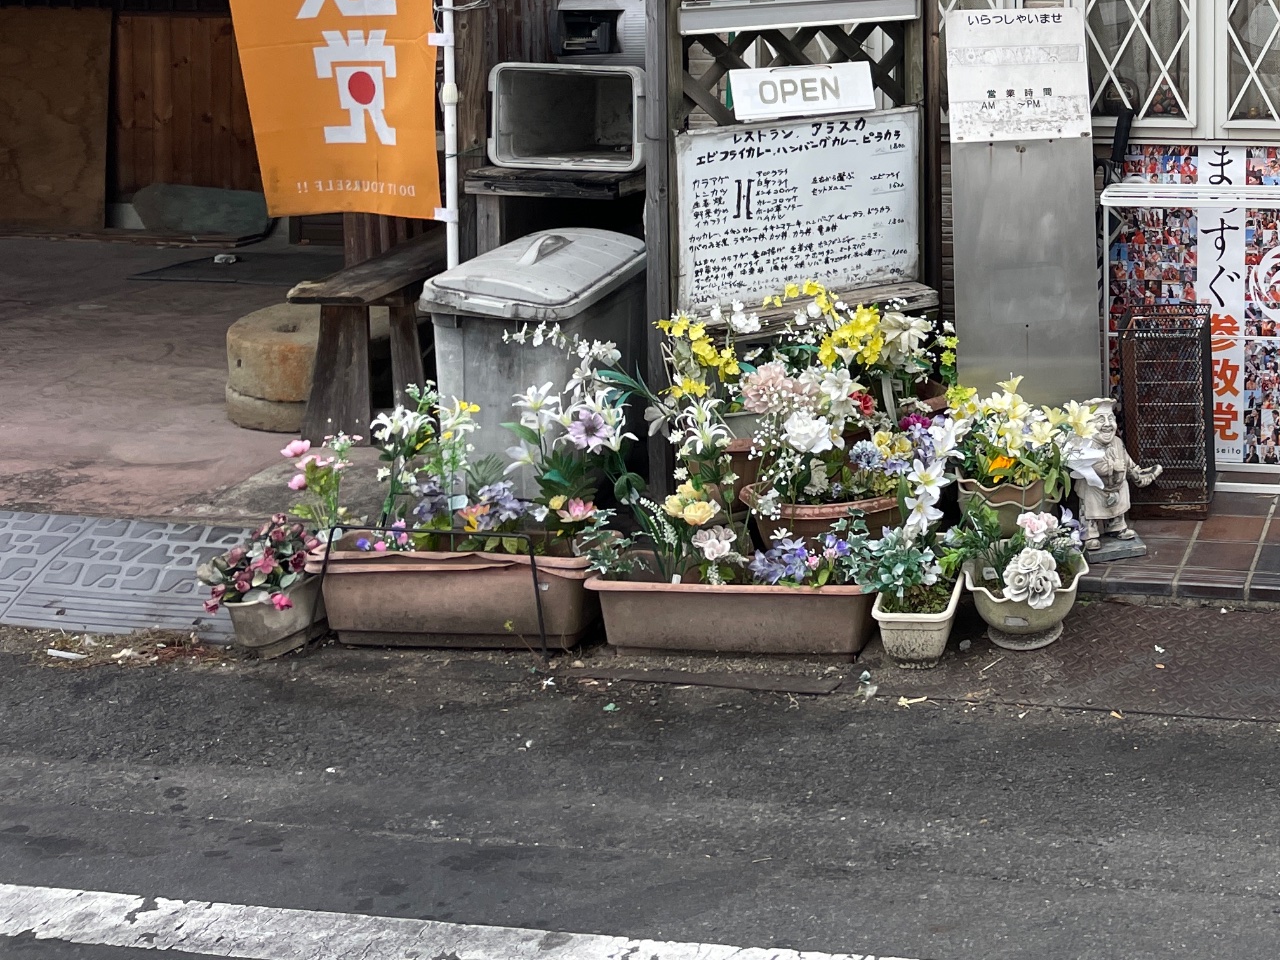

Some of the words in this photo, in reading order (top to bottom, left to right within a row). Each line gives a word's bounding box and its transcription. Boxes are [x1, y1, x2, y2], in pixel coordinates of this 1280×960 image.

[758, 76, 841, 105] OPEN
[986, 87, 1053, 99] 営業時間
[981, 101, 996, 110] AM
[811, 117, 866, 136] アラスカ
[1201, 146, 1241, 307] ますぐ
